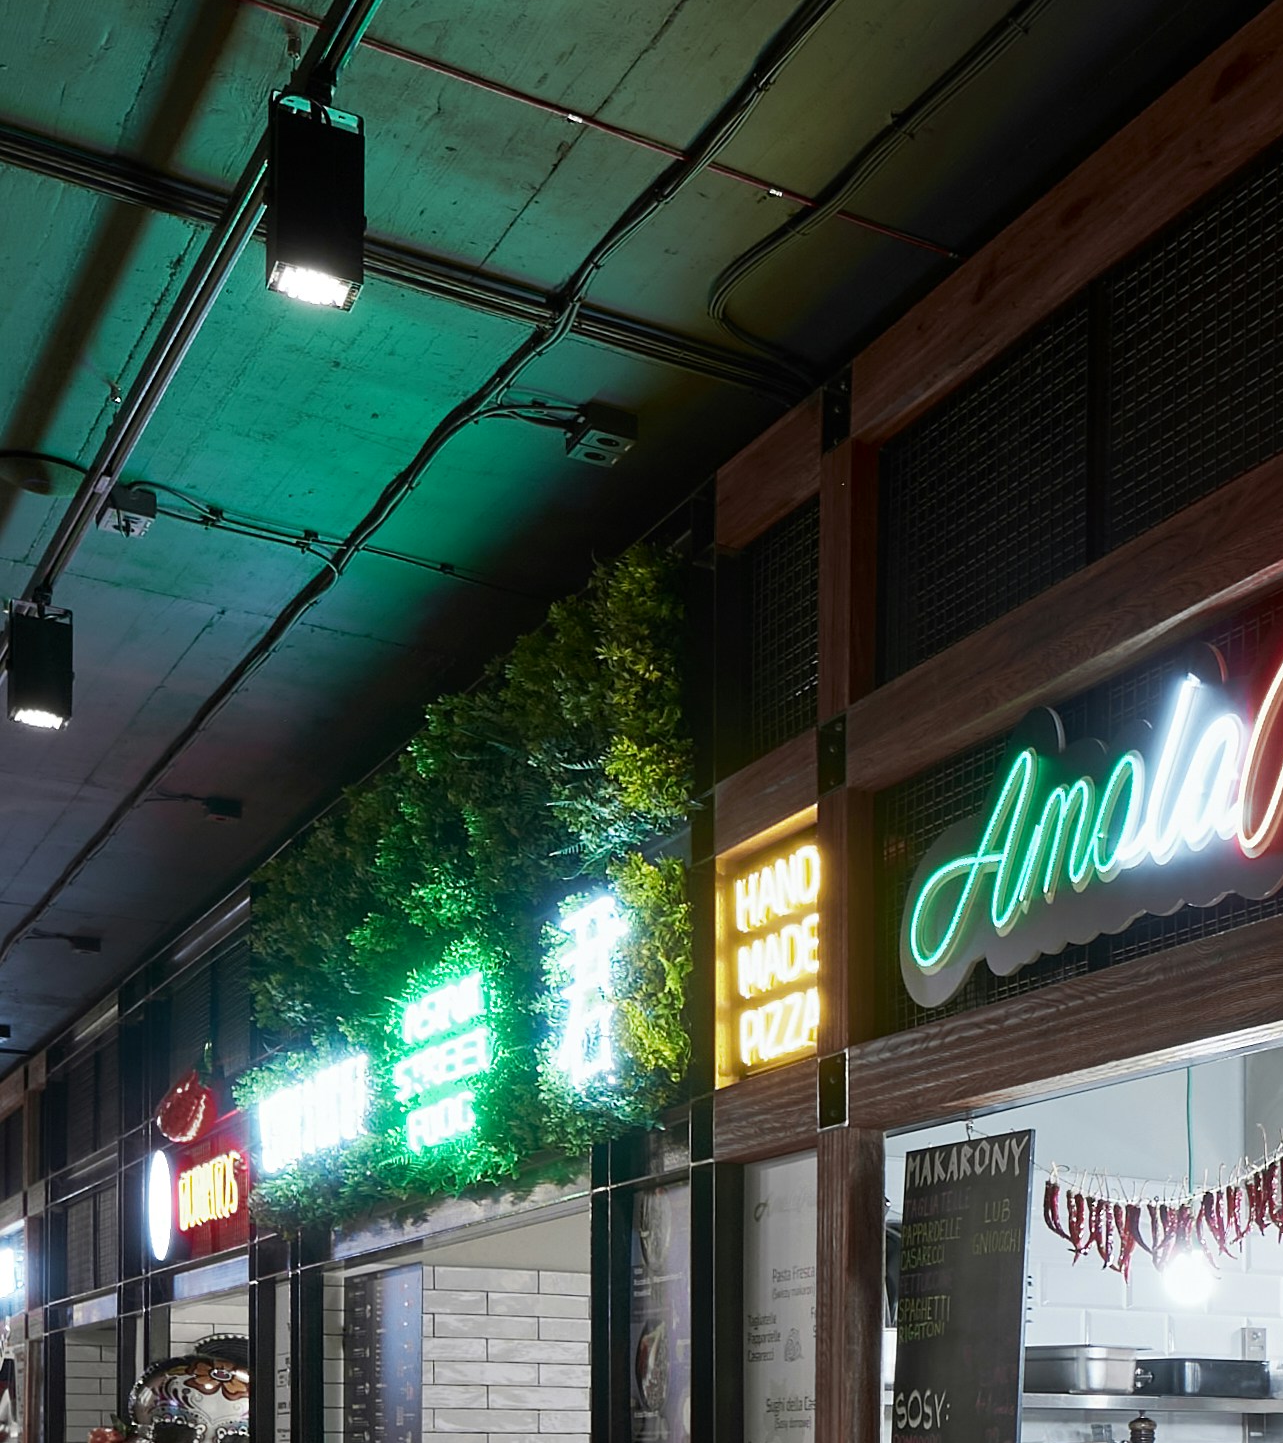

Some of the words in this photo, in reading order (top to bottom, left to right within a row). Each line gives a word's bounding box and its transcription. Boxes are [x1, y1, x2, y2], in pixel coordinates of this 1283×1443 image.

[735, 845, 821, 933] HAND
[738, 913, 819, 999] MADE
[740, 987, 820, 1067] PIZZA
[906, 1135, 1029, 1191] MAKARONY
[902, 1216, 963, 1247] PAPPARDELLE
[984, 1198, 1011, 1224] LUB
[898, 1295, 951, 1323] SPAGHETTI
[899, 1320, 945, 1344] RIGATONI
